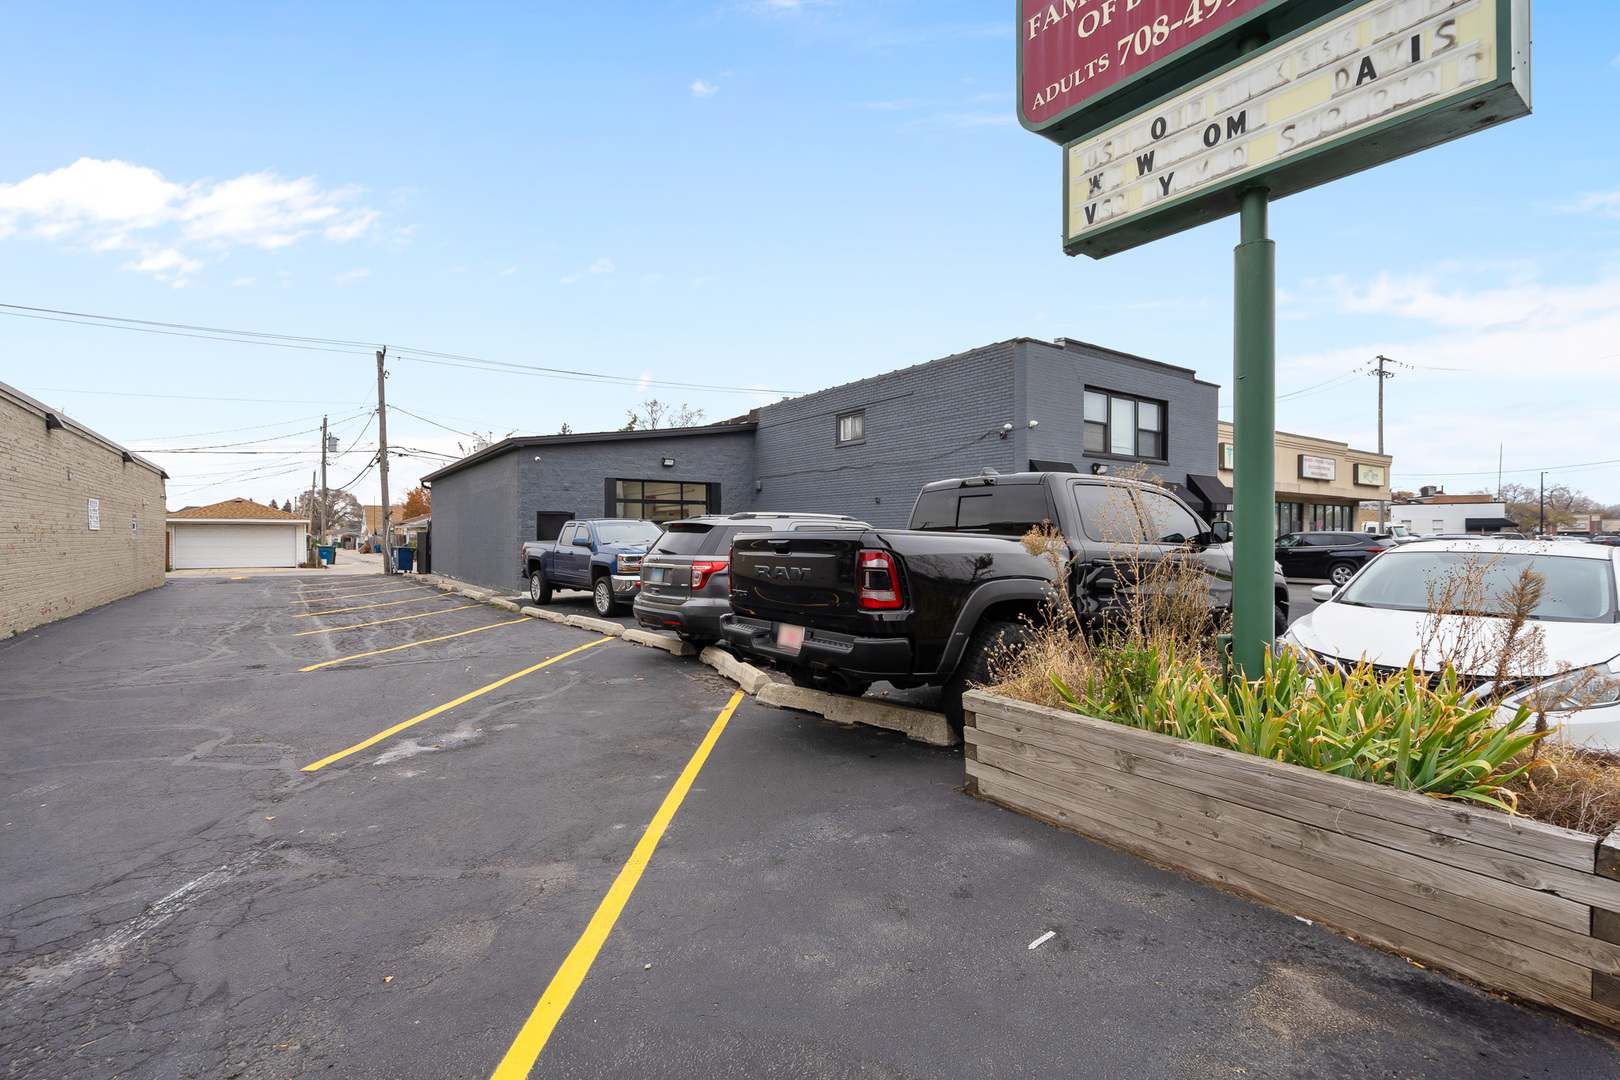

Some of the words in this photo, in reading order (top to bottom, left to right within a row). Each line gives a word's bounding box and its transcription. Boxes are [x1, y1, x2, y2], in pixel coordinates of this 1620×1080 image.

[1077, 0, 1117, 38] OF
[1031, 53, 1110, 111] ADULTS
[754, 564, 812, 582] RAM
